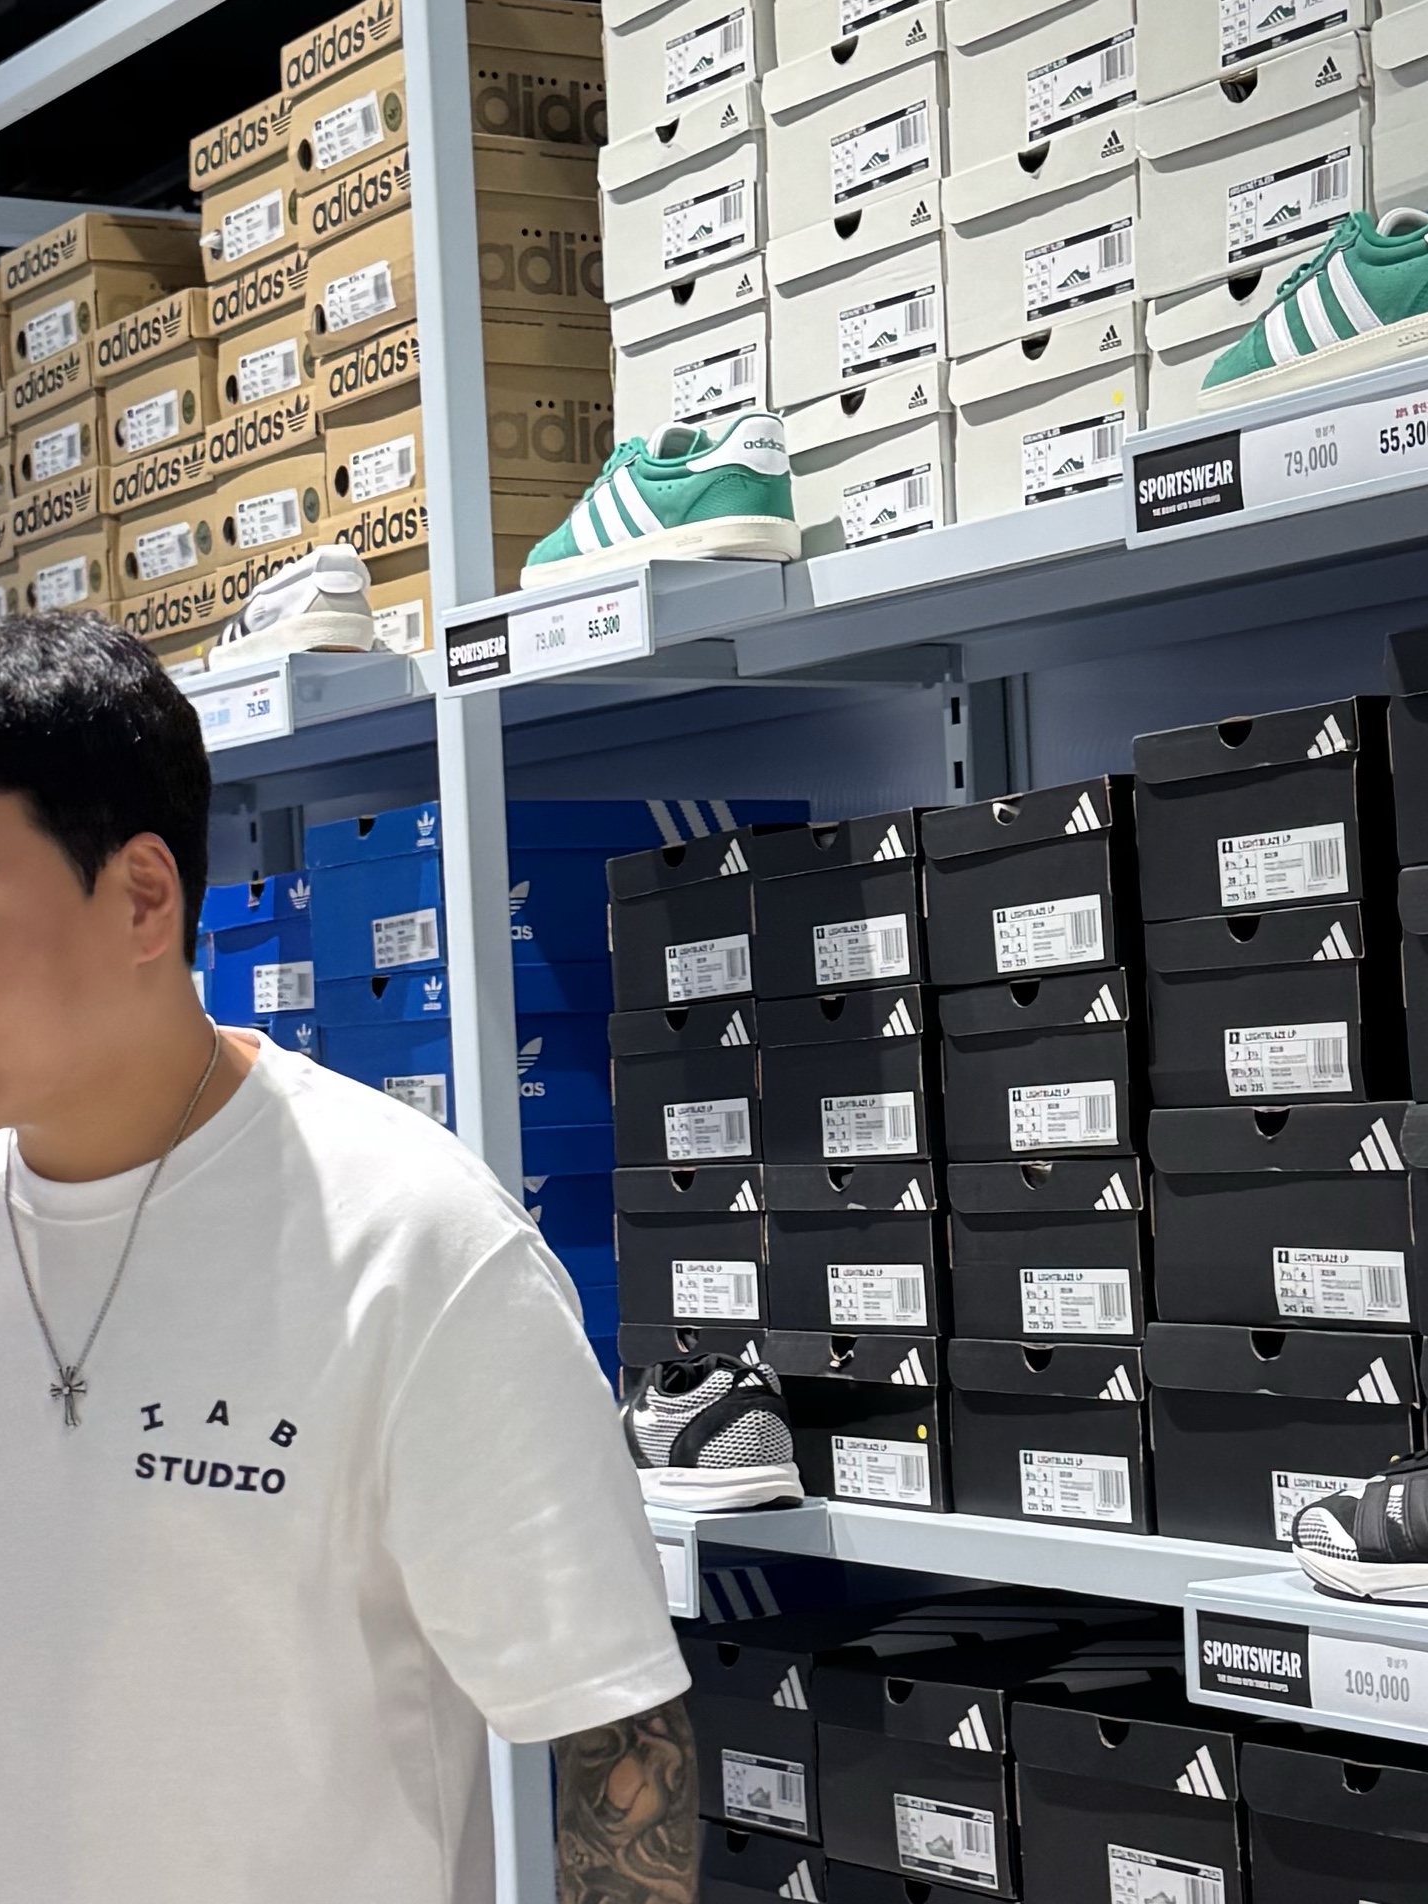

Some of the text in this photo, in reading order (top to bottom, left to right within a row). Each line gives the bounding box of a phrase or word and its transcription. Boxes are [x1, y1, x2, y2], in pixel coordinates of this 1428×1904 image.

[287, 20, 365, 89] adidas
[194, 116, 269, 176] adidas
[313, 169, 392, 235] adidas
[8, 242, 60, 289] adidas
[213, 268, 284, 325] adidas
[98, 316, 163, 367] adidas
[15, 361, 64, 409] adidas
[330, 336, 408, 398] adidas
[210, 408, 285, 465] adidas
[1284, 441, 1338, 477] 79,000
[113, 455, 182, 506] adidas
[1138, 459, 1233, 505] SPORTSWEAR
[14, 489, 73, 536] adidas
[125, 591, 192, 636] adidas
[588, 614, 621, 641] 55,300
[449, 635, 507, 667] SPORTSWEAR
[135, 1452, 286, 1494] STUDIO
[1203, 1640, 1303, 1679] SPORTSWEAR
[1345, 1669, 1410, 1703] 109,000
